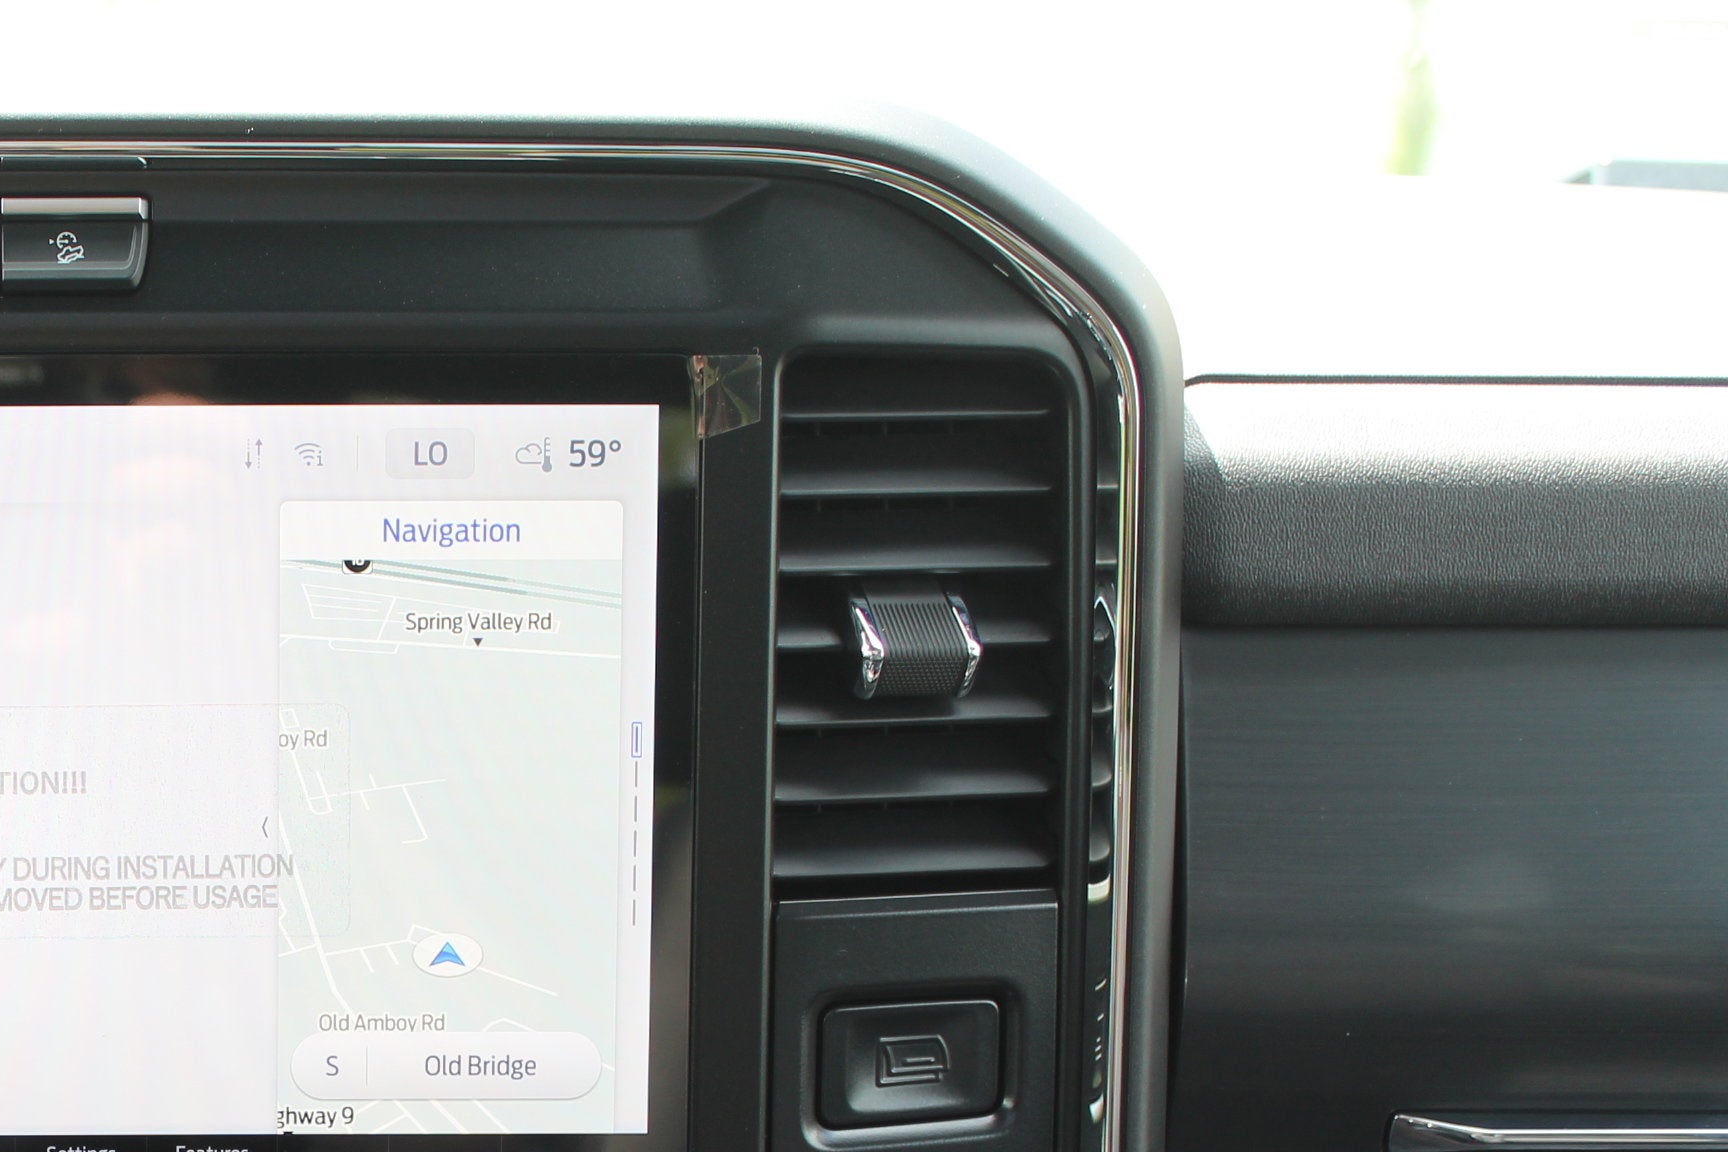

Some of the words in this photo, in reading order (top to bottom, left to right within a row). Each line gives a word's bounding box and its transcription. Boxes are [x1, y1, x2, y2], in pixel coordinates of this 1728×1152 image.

[414, 440, 448, 466] LO
[383, 518, 521, 548] Navigation
[405, 612, 463, 634] Spring
[467, 612, 524, 635] Valley
[528, 612, 552, 631] Rd
[303, 729, 328, 748] Rd
[13, 855, 111, 882] DURING
[117, 853, 294, 880] INSTALLATION
[88, 885, 188, 911] BEFORE
[192, 884, 279, 910] USAGE
[318, 1013, 350, 1032] Old
[354, 1013, 418, 1033] Amboy
[421, 1013, 445, 1032] Rd
[325, 1055, 339, 1077] S
[424, 1054, 462, 1076] Old
[468, 1054, 537, 1081] Bridge
[341, 1106, 354, 1125] 9
